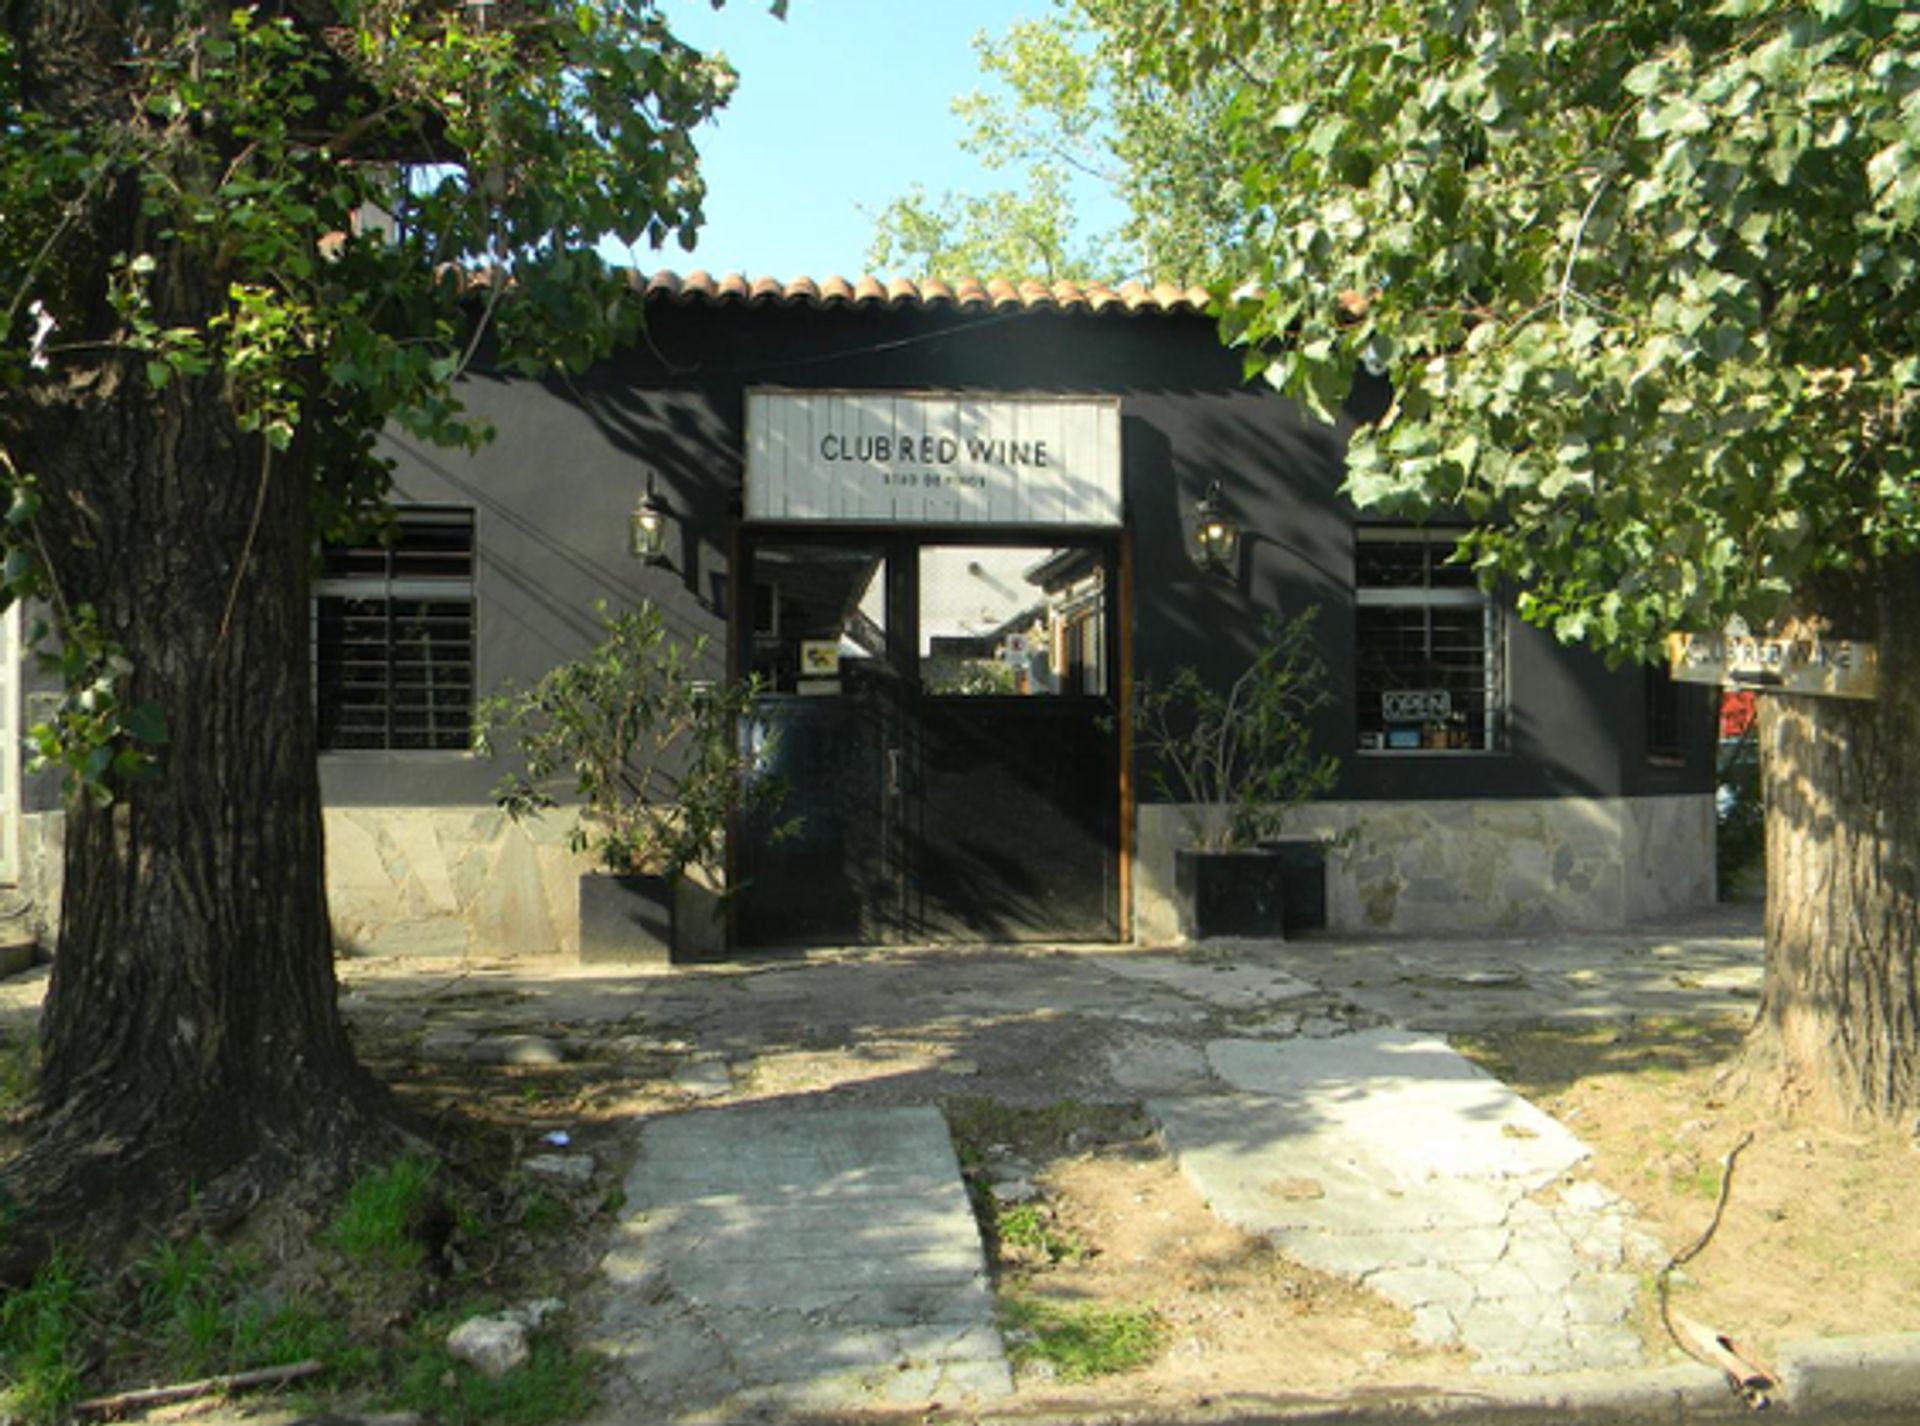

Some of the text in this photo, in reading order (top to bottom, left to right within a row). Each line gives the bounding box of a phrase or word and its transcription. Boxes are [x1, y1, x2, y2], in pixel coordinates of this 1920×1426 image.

[819, 434, 1048, 468] CLUB RED WINE
[1384, 691, 1449, 719] OPEN
